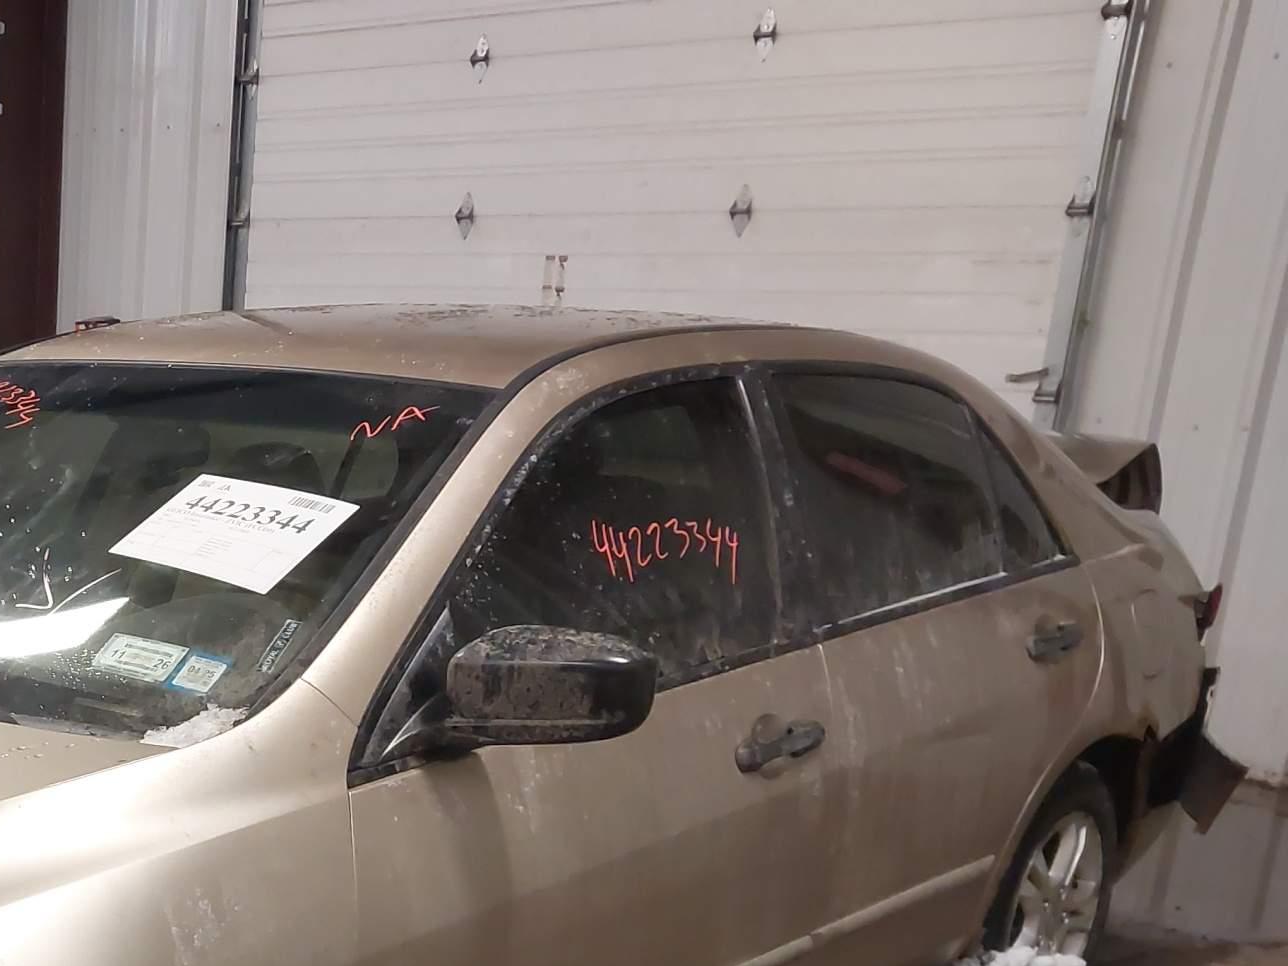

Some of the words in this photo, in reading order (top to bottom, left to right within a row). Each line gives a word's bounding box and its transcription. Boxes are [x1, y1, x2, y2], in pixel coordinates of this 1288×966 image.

[185, 495, 316, 534] 44223344
[591, 517, 739, 585] 44223344
[153, 657, 172, 671] 26
